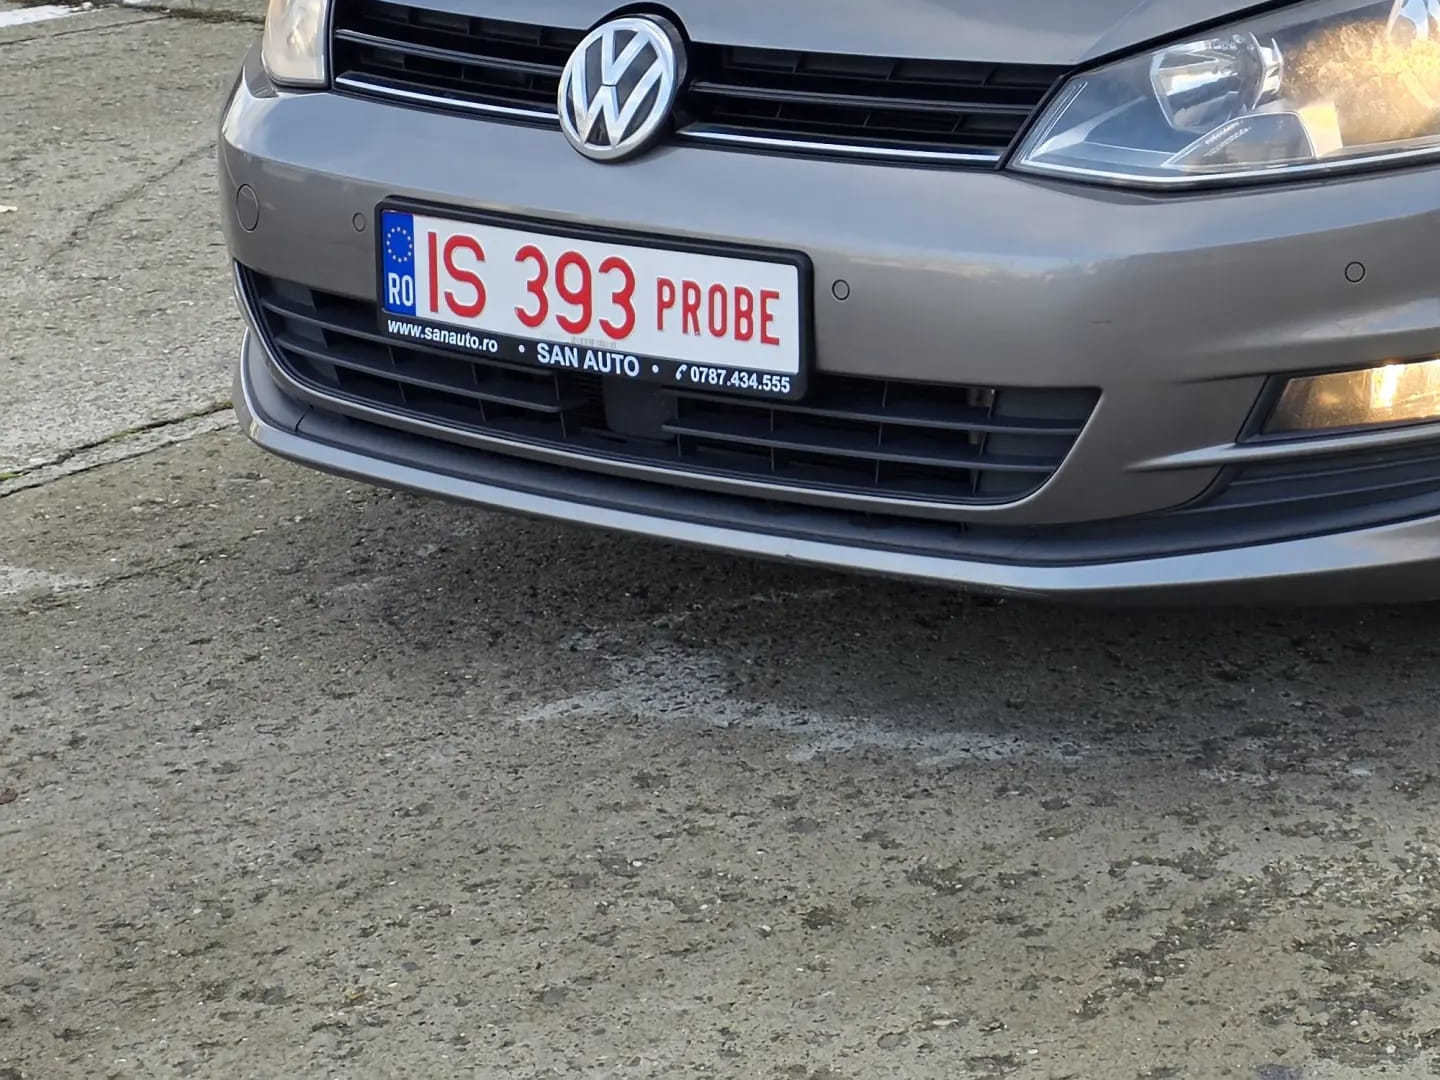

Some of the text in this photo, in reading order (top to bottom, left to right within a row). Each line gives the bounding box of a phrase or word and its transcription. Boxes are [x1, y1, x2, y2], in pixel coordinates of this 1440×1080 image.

[557, 17, 675, 160] VW
[388, 272, 415, 307] RO
[427, 230, 781, 346] IS 393 PROBE
[388, 319, 498, 353] www.sanauto.ro
[537, 343, 641, 377] SAN AUTO
[690, 366, 791, 393] 0787.434.555
